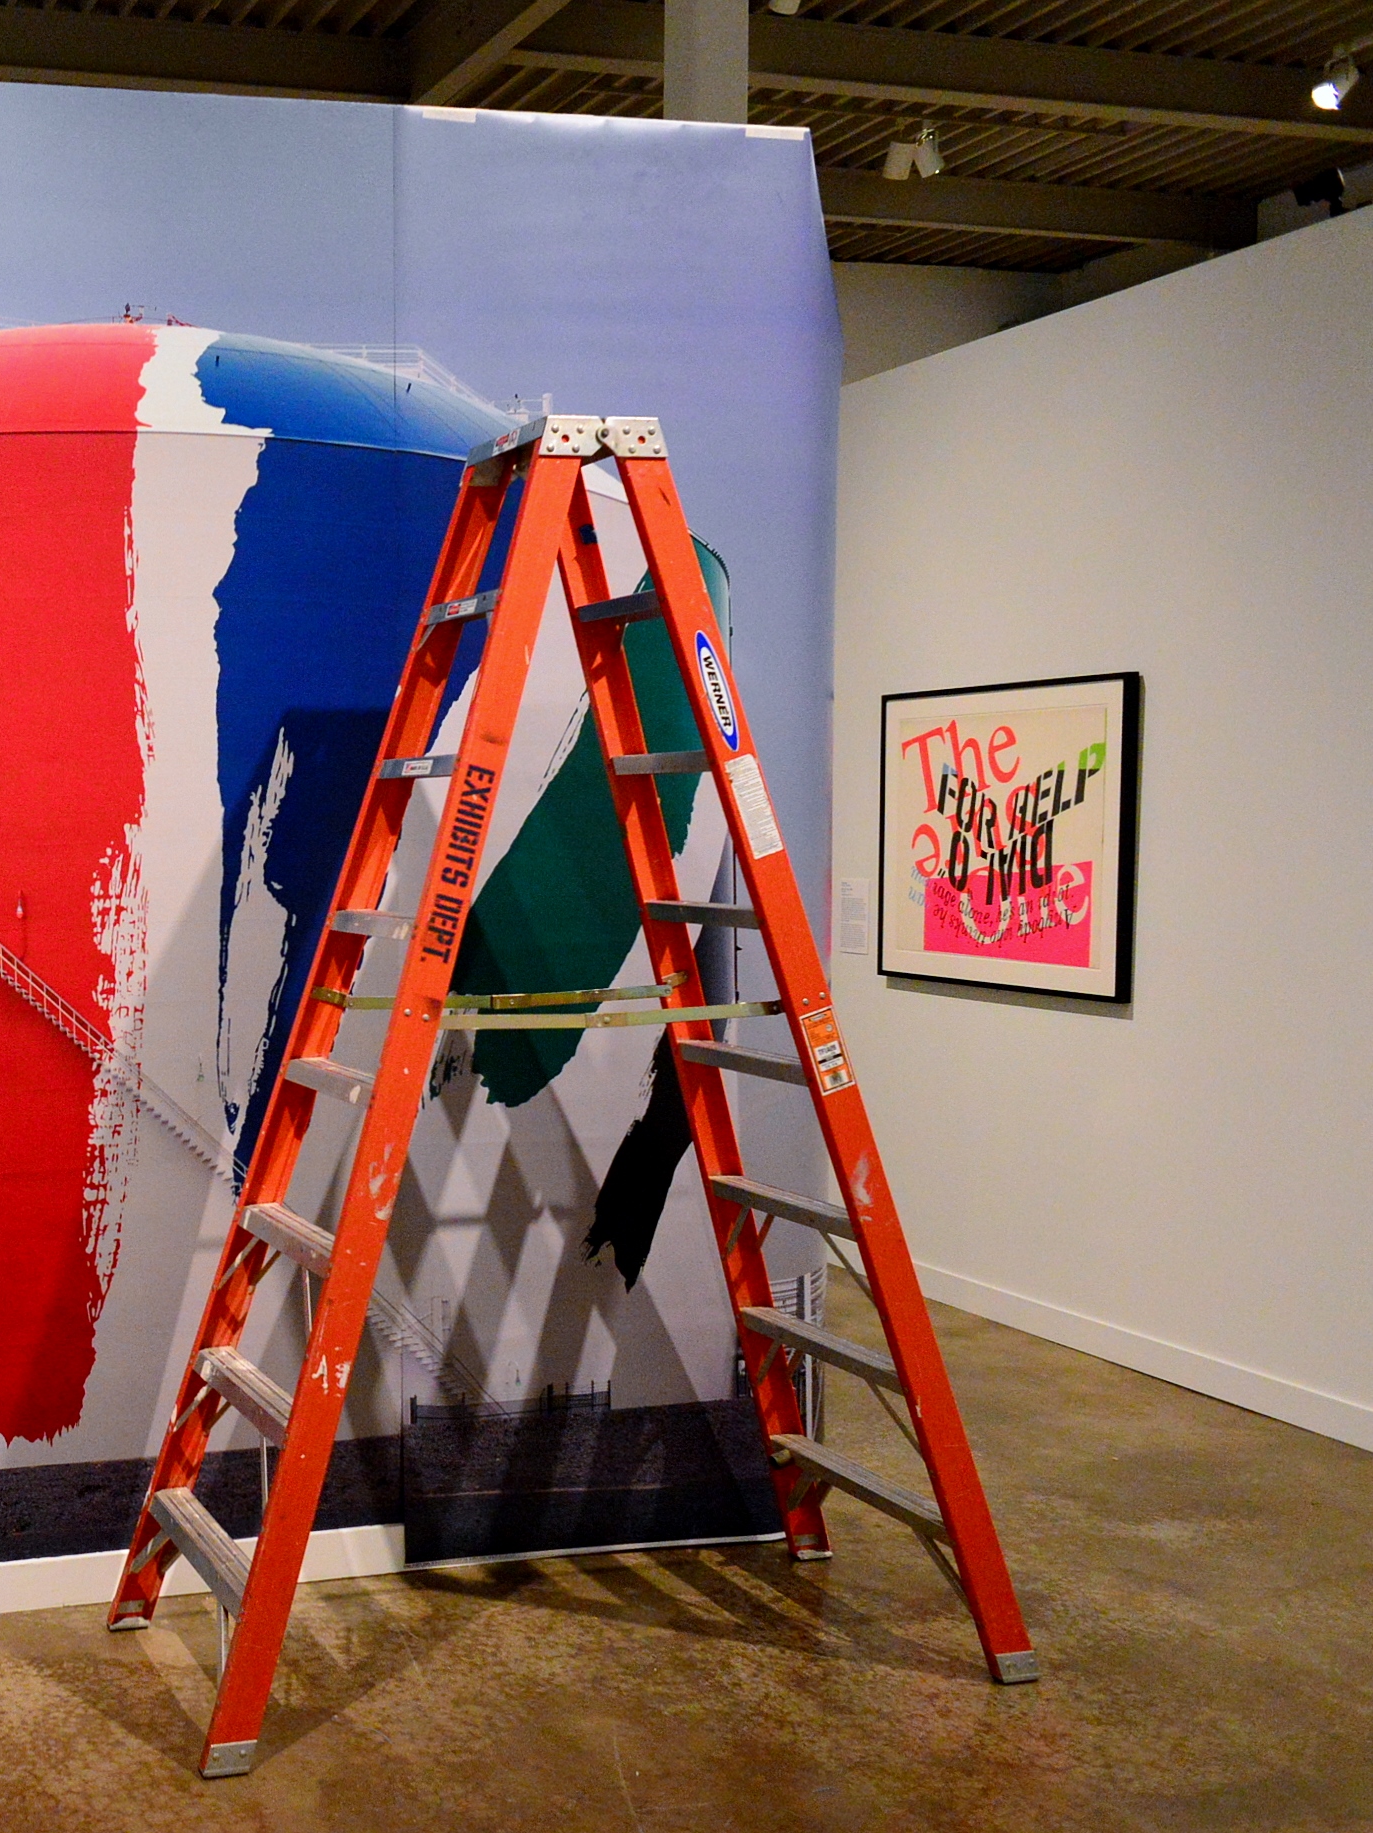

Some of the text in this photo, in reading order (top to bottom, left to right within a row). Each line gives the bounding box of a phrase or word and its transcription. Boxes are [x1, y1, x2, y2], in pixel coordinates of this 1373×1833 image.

[703, 655, 732, 727] WERNER
[901, 719, 1020, 813] The
[937, 742, 1106, 850] FOR HELP
[420, 764, 495, 963] EXHIBITS DEPT.
